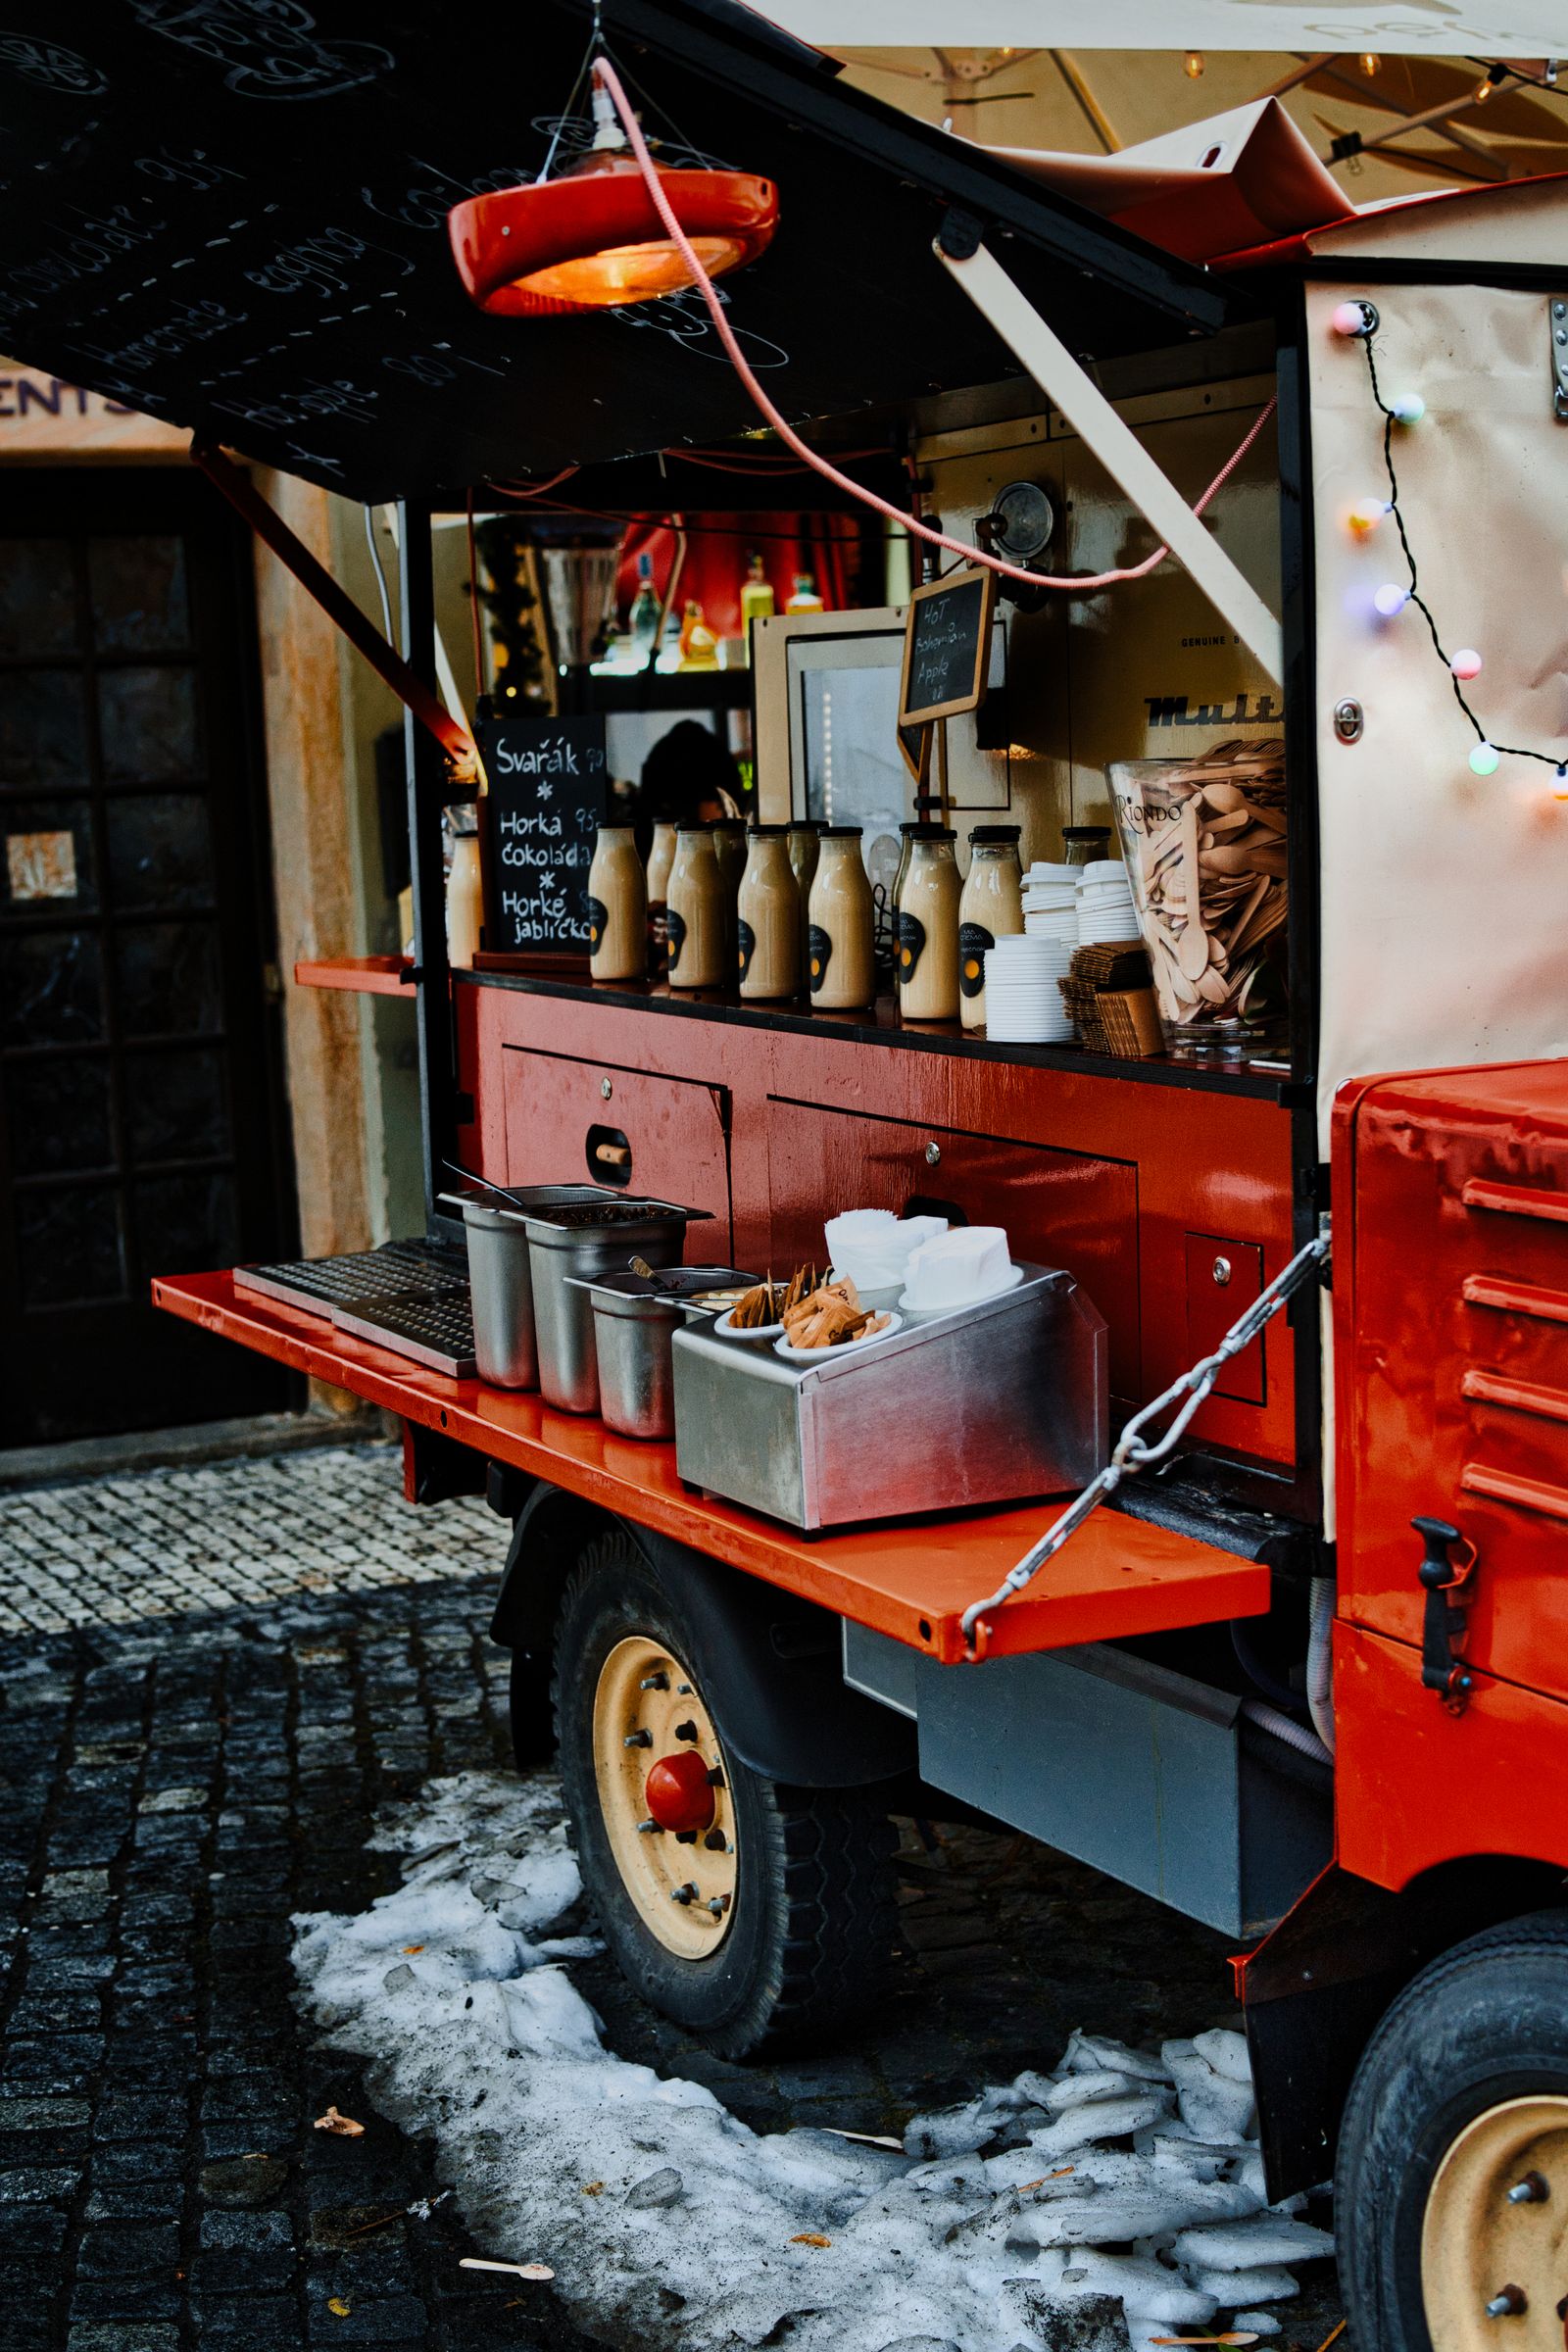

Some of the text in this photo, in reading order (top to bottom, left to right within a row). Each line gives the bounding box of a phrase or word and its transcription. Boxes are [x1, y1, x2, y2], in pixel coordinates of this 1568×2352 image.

[1181, 636, 1226, 648] GENUINE
[917, 656, 949, 685] Apple
[496, 737, 580, 775] Svařák
[500, 810, 563, 837] Horká
[501, 841, 592, 870] čokoláda
[502, 887, 567, 918] Horké
